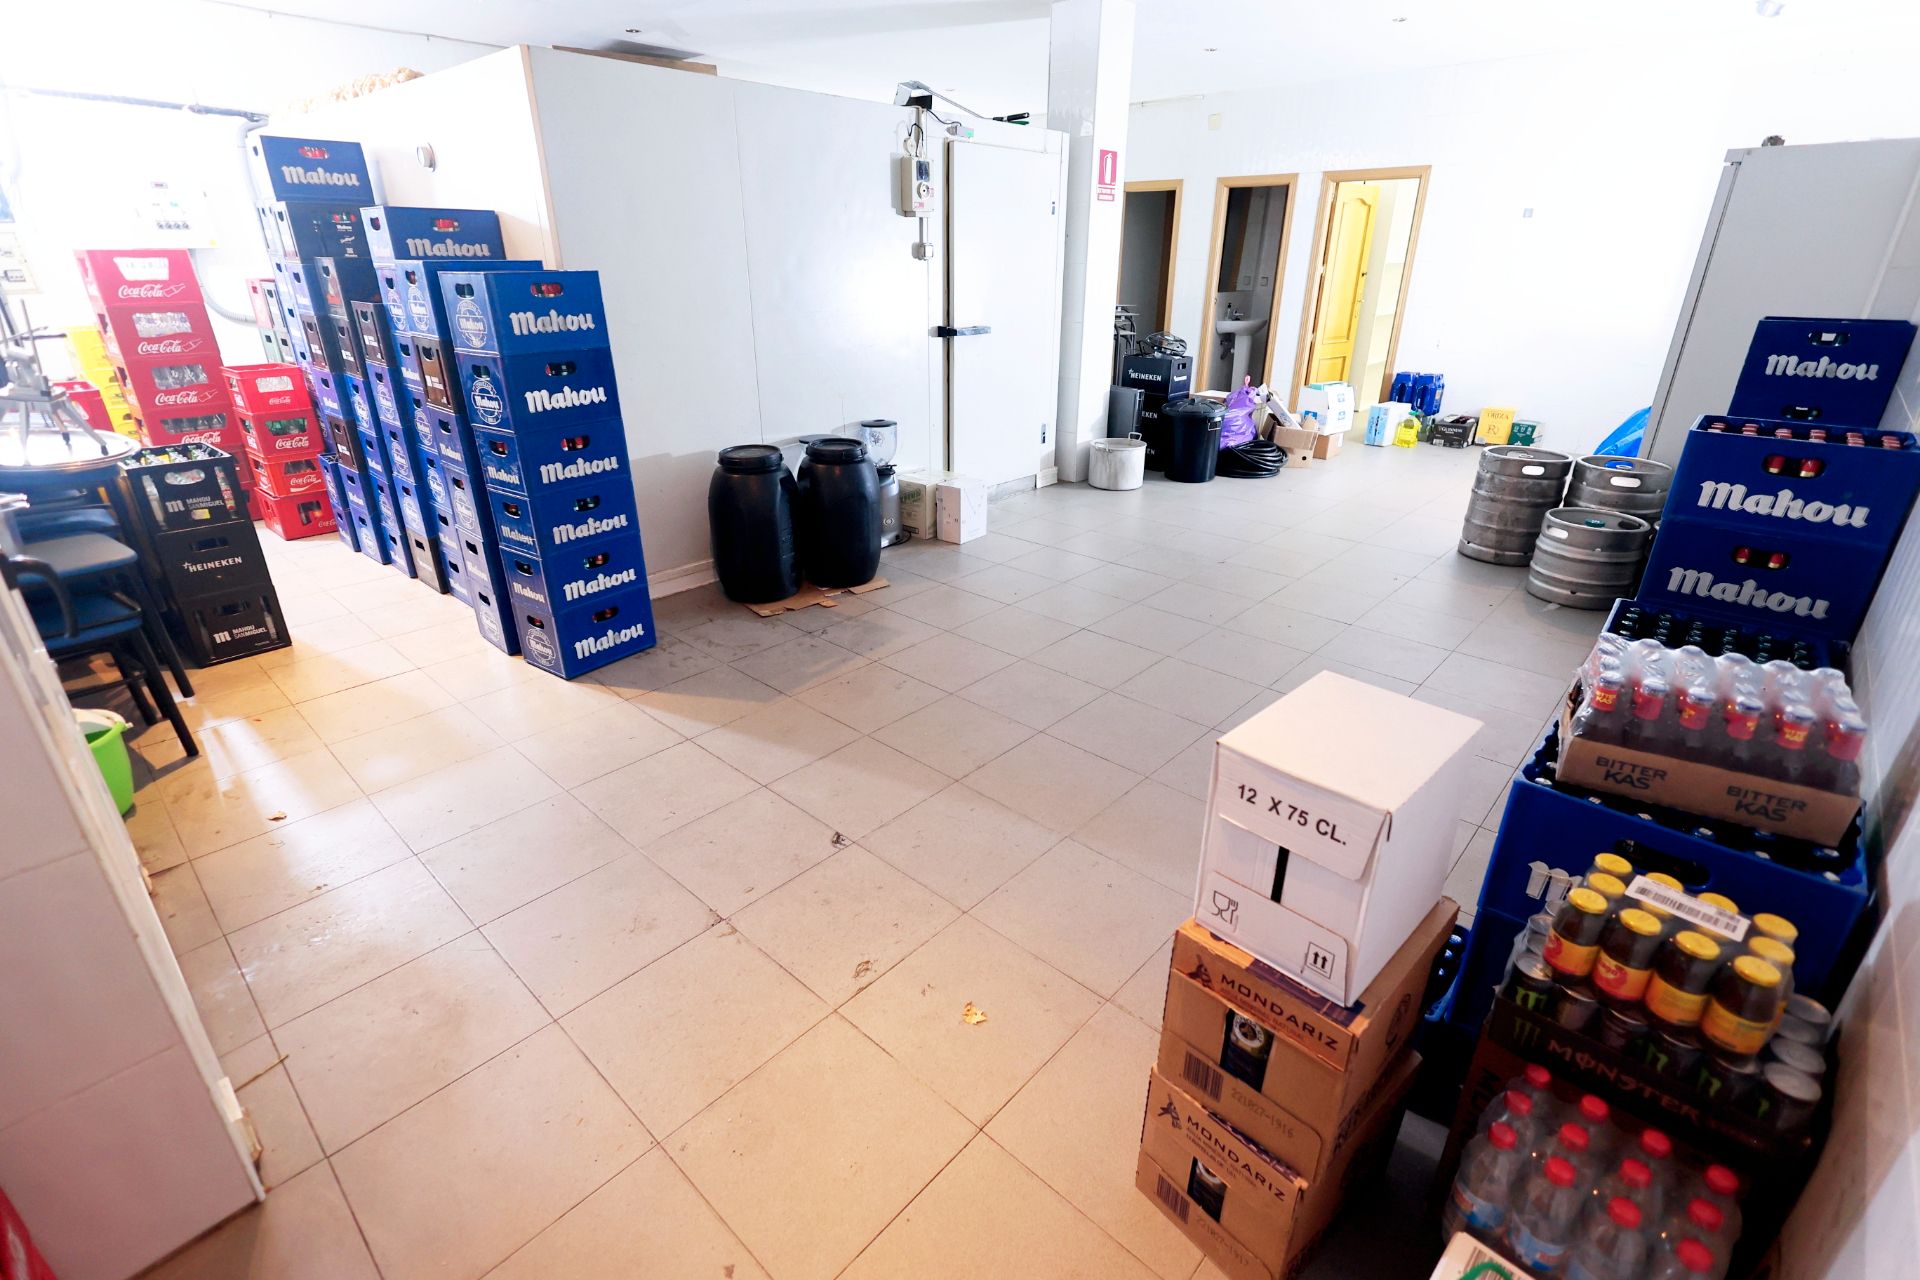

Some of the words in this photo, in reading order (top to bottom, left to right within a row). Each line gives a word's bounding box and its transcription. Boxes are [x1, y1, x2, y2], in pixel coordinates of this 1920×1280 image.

[281, 166, 360, 186] Mahou
[405, 238, 491, 257] Mahou
[509, 309, 595, 336] Mahou
[1130, 371, 1161, 382] HEINEKEN
[1765, 355, 1878, 381] Mahou
[524, 385, 607, 413] Mahou
[488, 466, 520, 485] Mahou
[539, 455, 619, 484] Mahou
[1697, 480, 1870, 528] Mahou
[501, 525, 534, 545] Mahou
[552, 513, 628, 545] Mahou
[188, 556, 243, 572] HEINEKEN
[513, 582, 545, 603] Mahou
[562, 568, 637, 601] Mahou
[1666, 567, 1830, 620] Mahou
[574, 623, 645, 660] Mahou
[1596, 755, 1667, 781] BITTER
[1603, 769, 1651, 790] KAS
[1726, 785, 1808, 811] BITTER
[1734, 799, 1787, 822] KAS
[1237, 784, 1257, 804] 12
[1268, 797, 1282, 816] X
[1287, 805, 1308, 827] 75
[1315, 818, 1347, 845] CL.
[1221, 974, 1338, 1051] MONDARIZ
[1187, 1114, 1286, 1202] MONDARIZ
